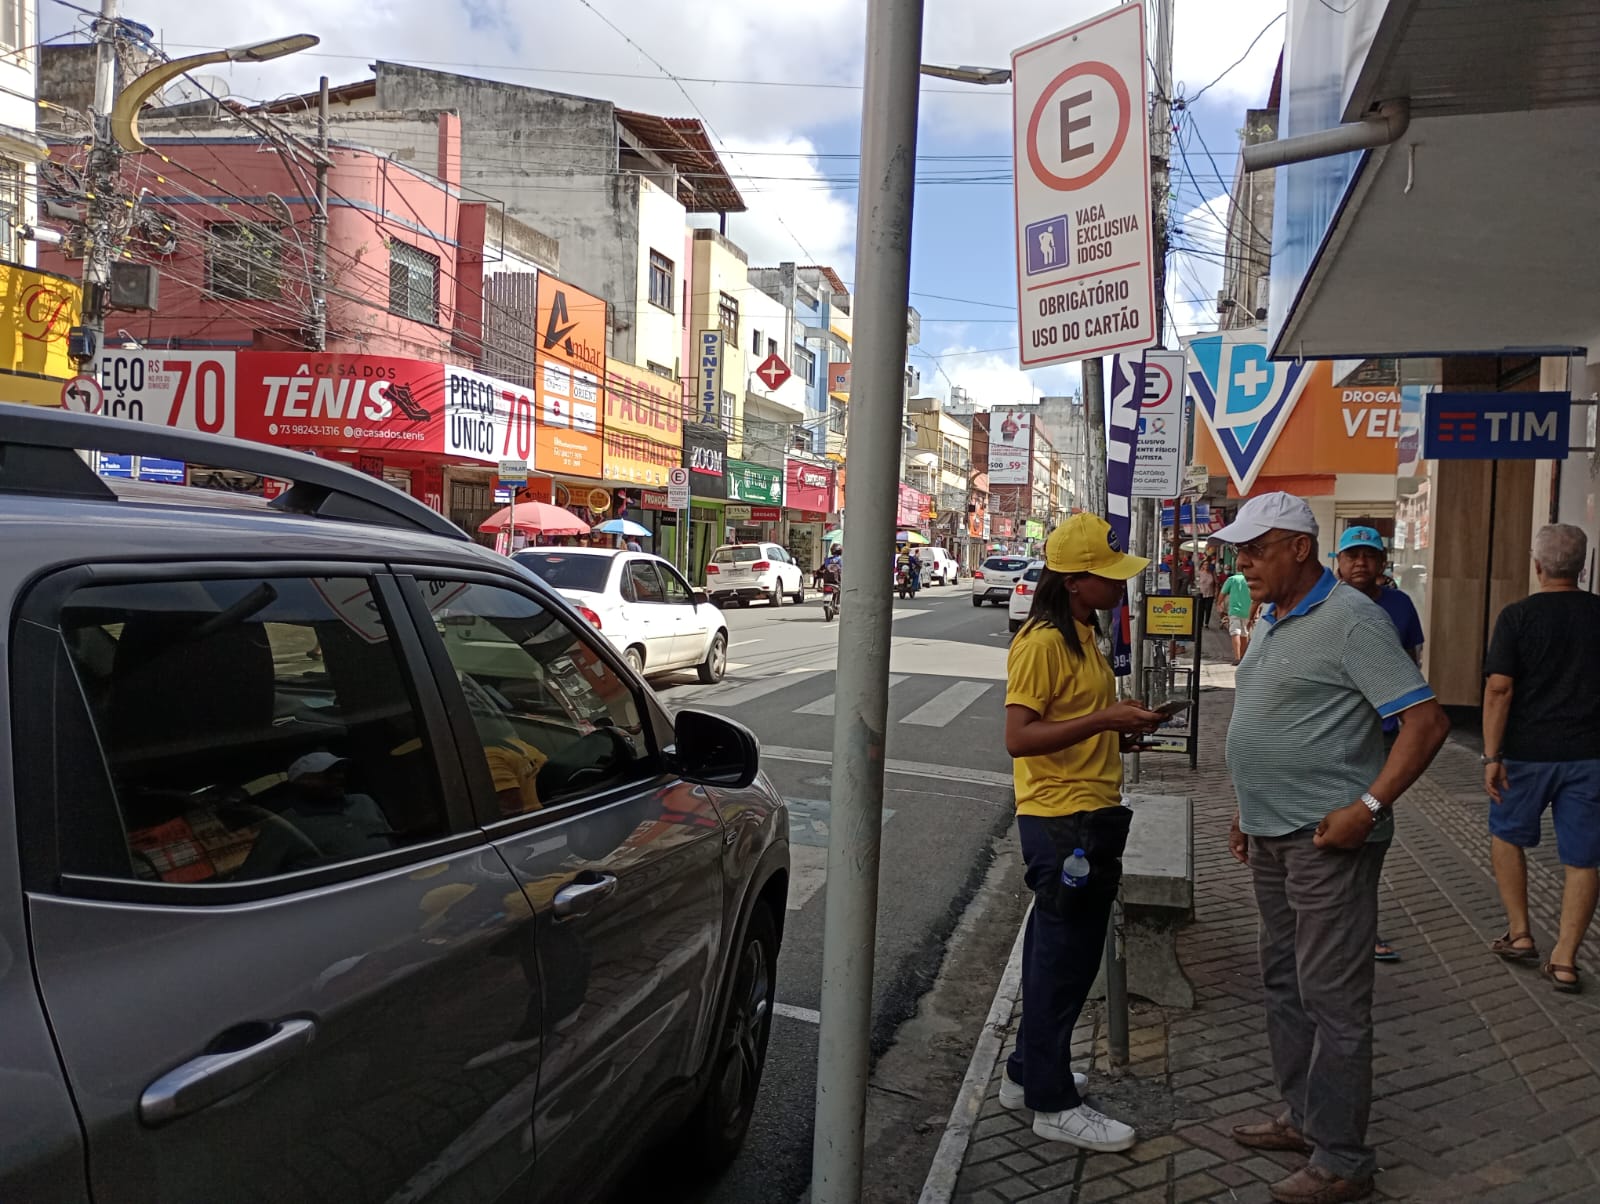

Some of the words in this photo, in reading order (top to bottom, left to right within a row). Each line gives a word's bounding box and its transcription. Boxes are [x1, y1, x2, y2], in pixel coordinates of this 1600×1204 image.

[1060, 90, 1094, 163] E
[1076, 204, 1105, 226] VAGA
[1077, 214, 1139, 245] EXCLUSIVA
[1077, 241, 1112, 264] IDOSO
[1039, 280, 1129, 317] OBRIGATÓRIO
[1032, 326, 1057, 348] USO
[1062, 321, 1080, 343] DO
[1085, 306, 1139, 337] CARTÃO
[315, 363, 357, 377] CASA
[363, 366, 396, 379] DOS
[702, 334, 718, 424] DENTISTA
[102, 357, 144, 397] EÇO
[163, 360, 225, 434] 70
[262, 363, 393, 422] TÊNIS
[280, 425, 290, 434] 73
[292, 425, 339, 436] 98243-1316
[354, 427, 424, 441] @casados.tenis
[451, 374, 494, 419] PREÇO
[502, 390, 531, 460] 70
[451, 408, 493, 455] ÚNICO
[1342, 408, 1401, 437] VEL
[1484, 412, 1558, 441] TIM
[607, 431, 678, 468] VARIEDADES
[690, 446, 723, 473] ZOOM
[675, 472, 682, 481] E
